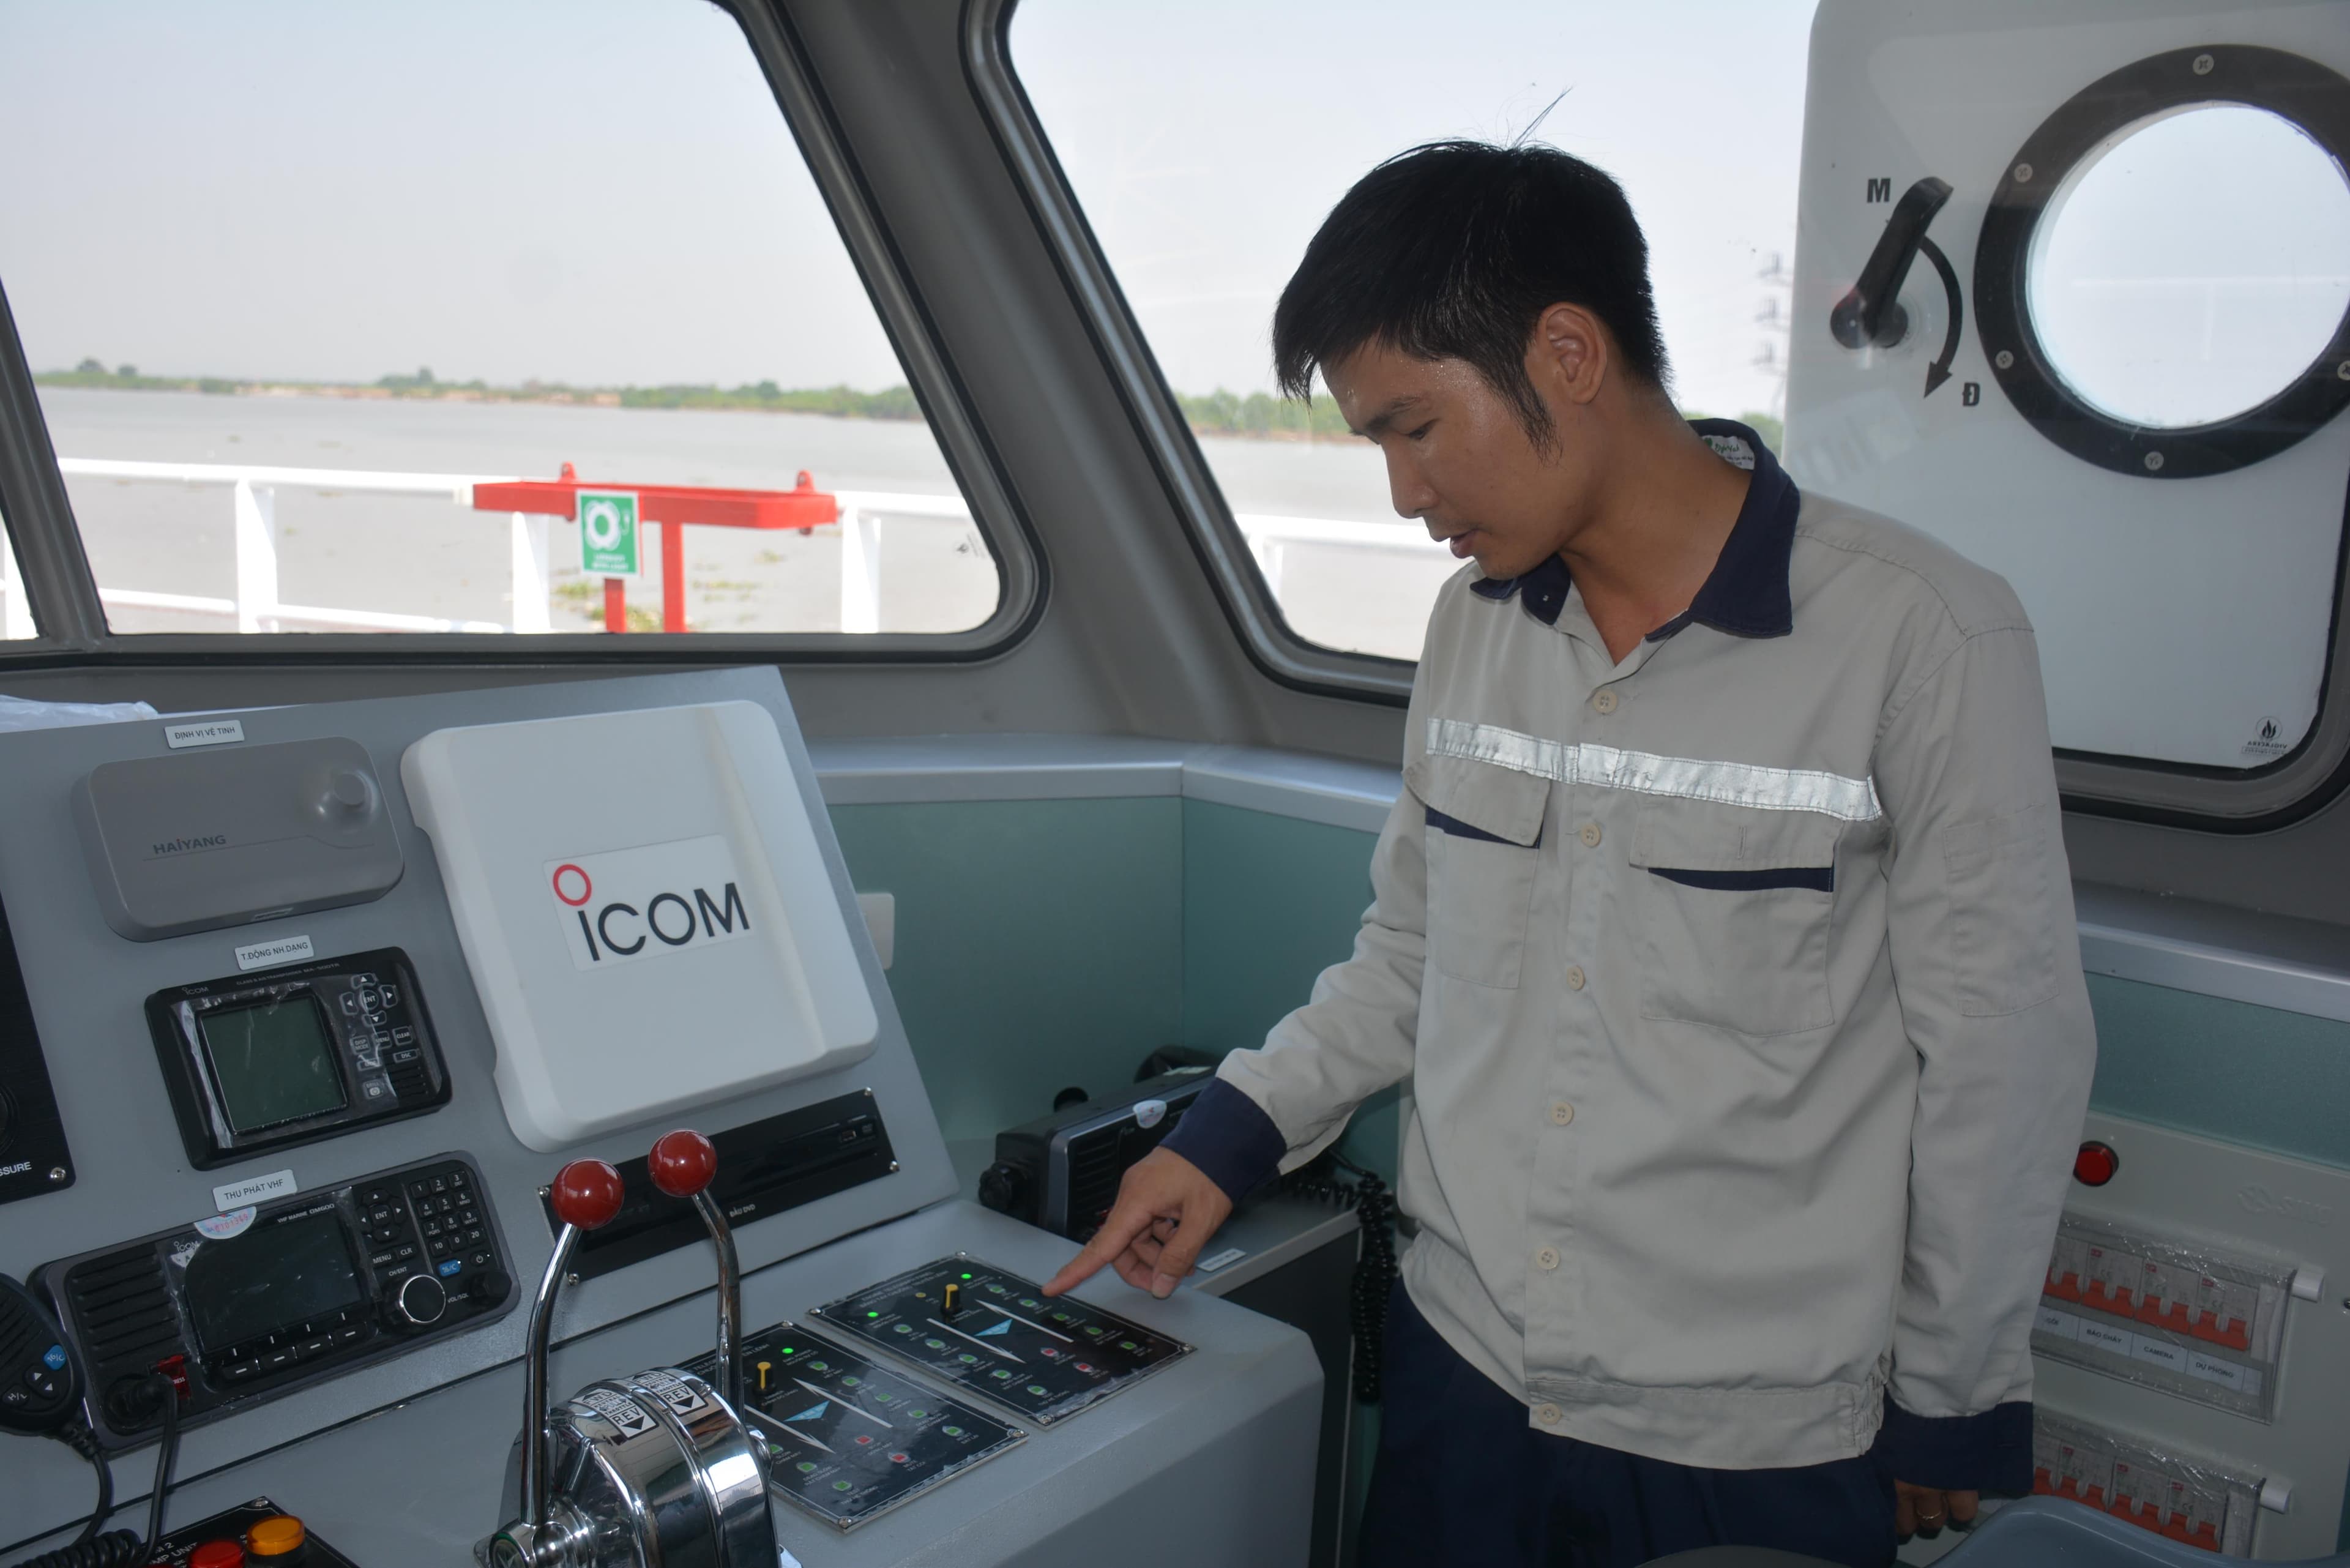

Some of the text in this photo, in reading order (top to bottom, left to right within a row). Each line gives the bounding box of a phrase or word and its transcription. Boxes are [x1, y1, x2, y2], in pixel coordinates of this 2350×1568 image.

[1867, 178, 1891, 204] M
[224, 1190, 242, 1201] THU
[267, 1179, 284, 1190] VHF
[375, 1211, 387, 1220] ENT
[471, 1230, 480, 1239] 20
[371, 1253, 392, 1265] MENU
[400, 1247, 413, 1256] CLR
[663, 1387, 690, 1402] REV
[612, 1408, 641, 1425] REV
[171, 1542, 197, 1557] UNIT
